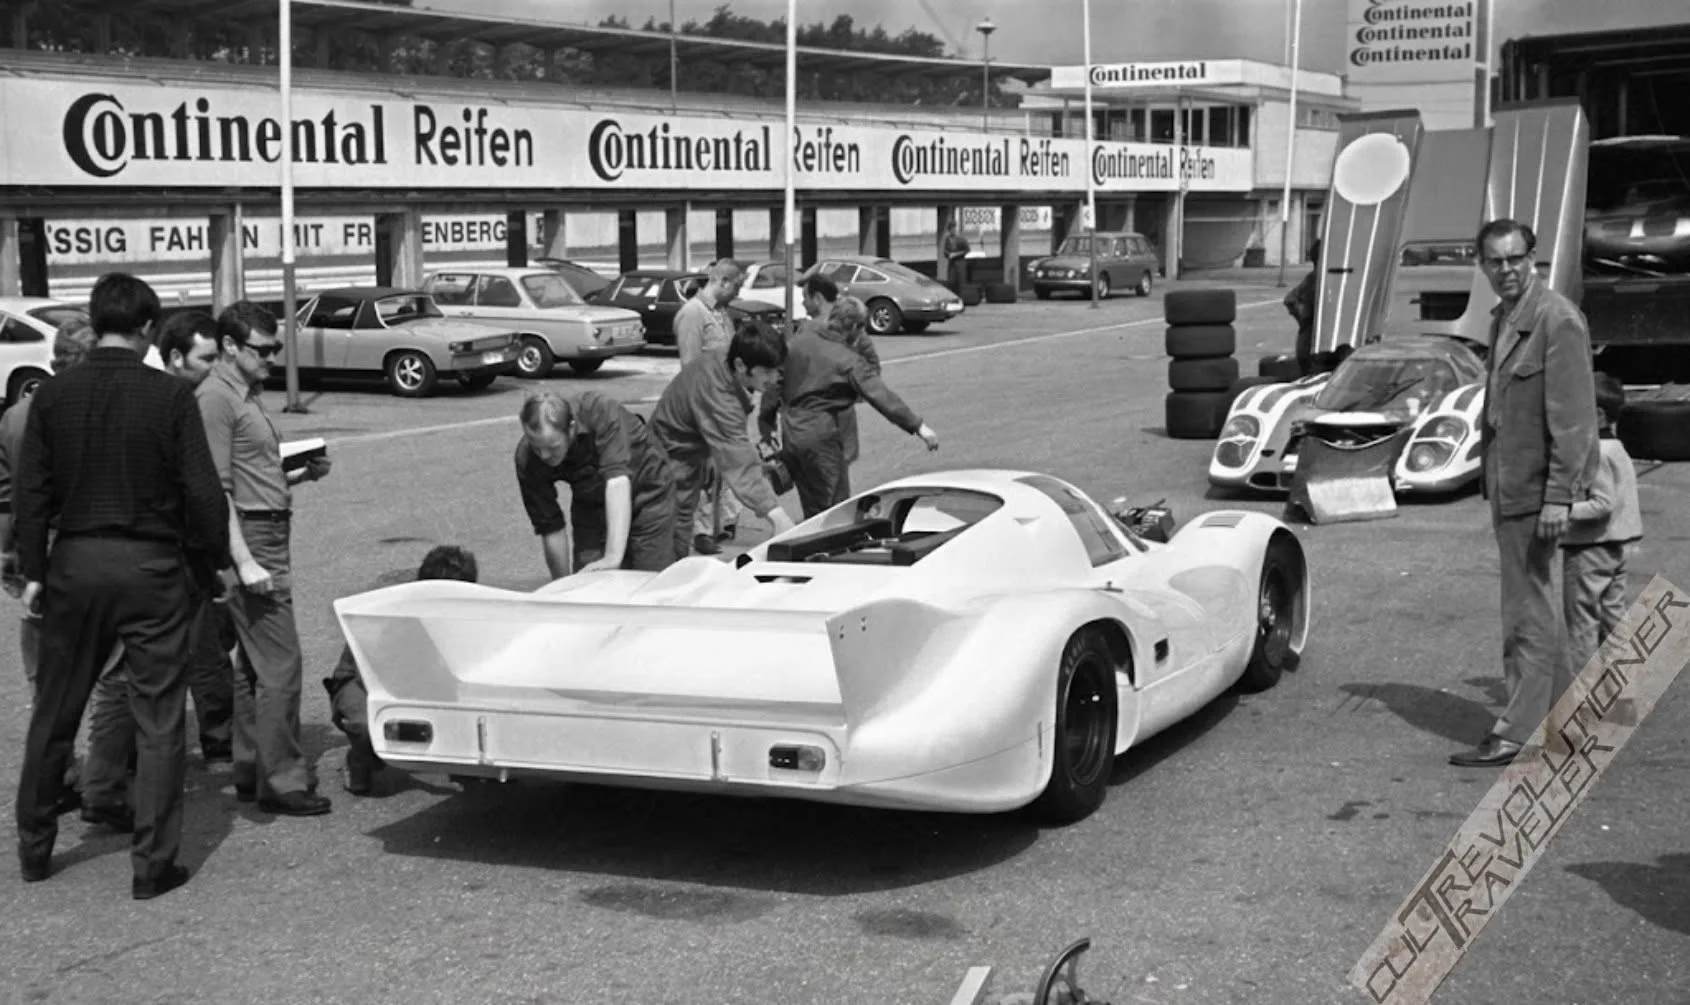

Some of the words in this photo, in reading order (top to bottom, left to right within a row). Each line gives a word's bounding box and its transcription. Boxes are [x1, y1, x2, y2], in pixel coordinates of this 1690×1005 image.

[1363, 1, 1472, 25] Continental
[1355, 20, 1471, 45] Continental
[1350, 42, 1471, 67] Continental
[1089, 62, 1206, 87] Continental
[63, 92, 387, 177] Continental
[413, 104, 533, 167] Reifen
[588, 118, 772, 182] Continental
[892, 134, 1010, 185] Continental
[1019, 138, 1070, 177] Reifen
[1092, 145, 1174, 186] Continental
